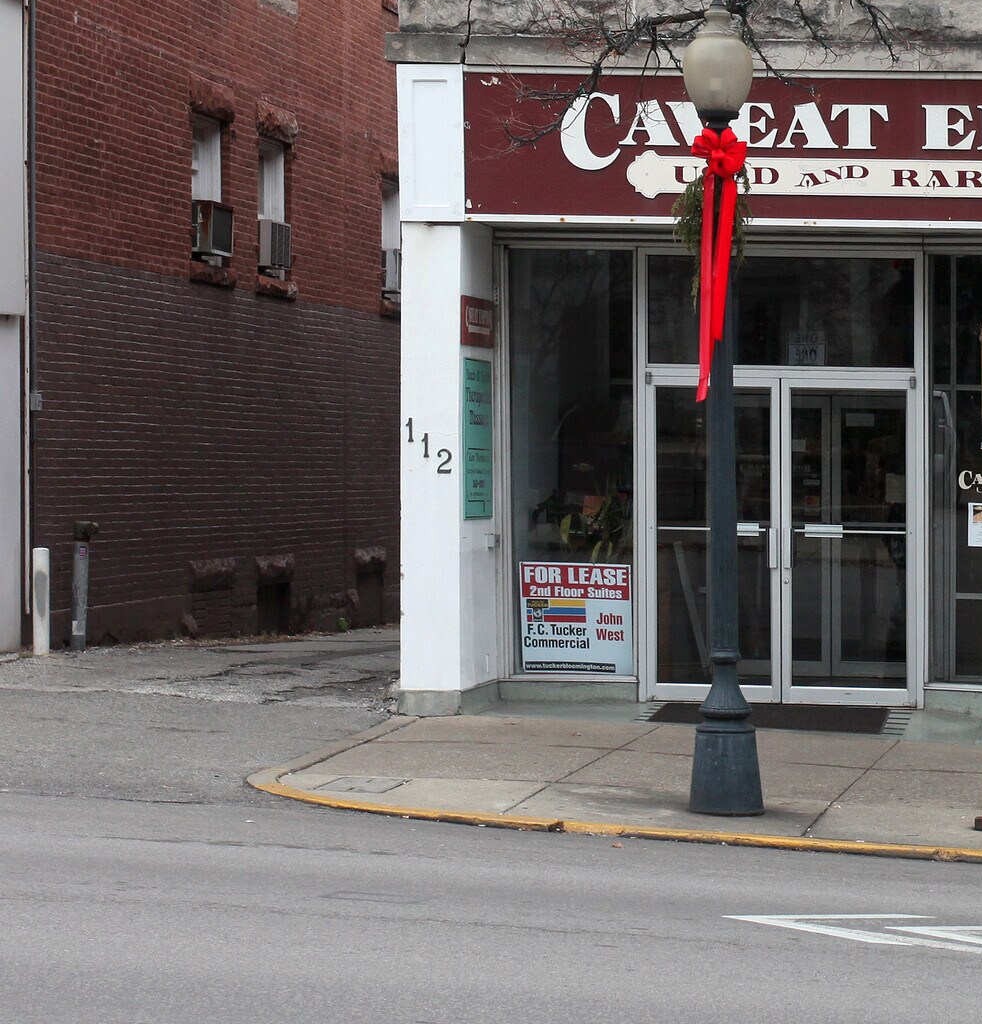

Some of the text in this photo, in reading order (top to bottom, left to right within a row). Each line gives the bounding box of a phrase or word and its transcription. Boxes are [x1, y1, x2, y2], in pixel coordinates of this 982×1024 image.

[674, 165, 779, 184] UD
[798, 164, 870, 188] AND
[523, 566, 628, 586] FOR LEASE
[529, 585, 622, 599] 2nd Floor Suites
[596, 612, 623, 625] John
[527, 623, 587, 636] F.C. Tucker
[596, 629, 625, 642] West
[524, 636, 590, 649] Commercial
[525, 663, 616, 672] www.tuckerbloomington.com
